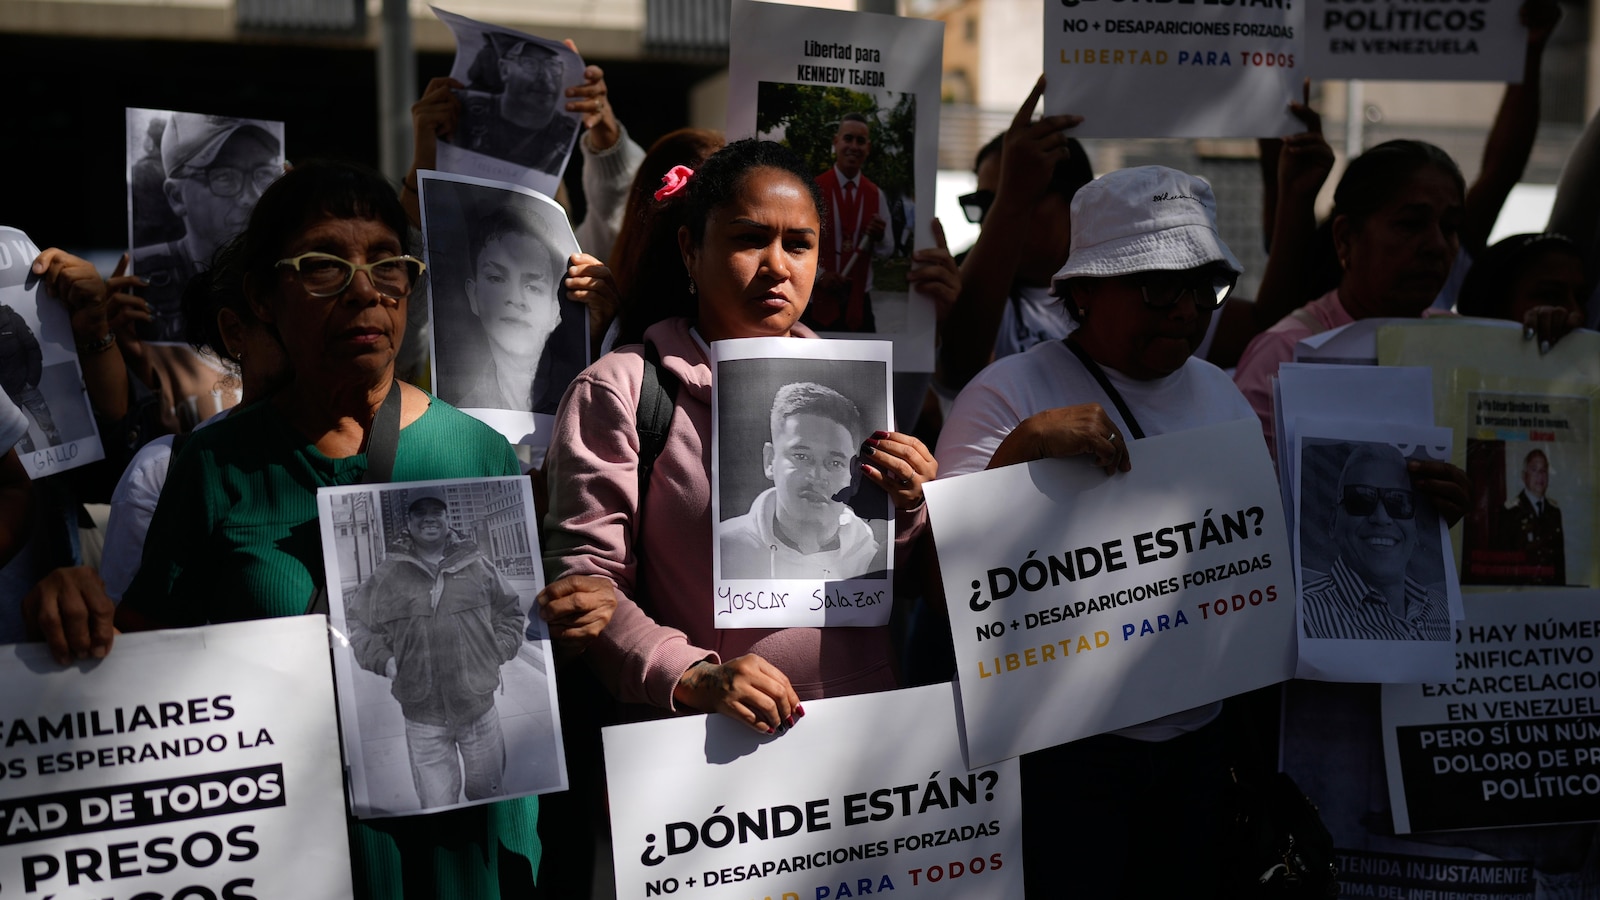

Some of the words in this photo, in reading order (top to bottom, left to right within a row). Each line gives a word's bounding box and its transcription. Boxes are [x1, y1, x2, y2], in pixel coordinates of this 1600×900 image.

[1063, 19, 1088, 33] NO
[1105, 19, 1230, 36] DESAPARICIONES
[1233, 23, 1294, 39] FORZADAS
[1324, 5, 1486, 31] POLÍTICOS
[804, 40, 852, 60] Libertad
[855, 47, 880, 63] para
[1060, 49, 1168, 65] LIBERTAD
[1178, 51, 1231, 66] PARA
[1240, 52, 1295, 69] TODOS
[1329, 39, 1355, 53] EN
[1361, 39, 1479, 54] VENEZUELA
[797, 64, 846, 84] KENNEDY
[848, 68, 885, 87] TEJEDA
[33, 443, 79, 471] GALLO
[969, 539, 1127, 612] ¿DÓNDE
[1133, 506, 1264, 565] ESTÁN?
[809, 589, 885, 611] Salazar
[976, 621, 1005, 641] NO
[1025, 577, 1180, 629] DESAPARICIONES
[1183, 553, 1272, 590] FORZADAS
[977, 629, 1110, 679] LIBERTAD
[1123, 610, 1189, 641] PARA
[1198, 585, 1278, 620] TODOS
[1470, 624, 1517, 644] HAY
[1422, 671, 1600, 697] EXCARCELACIO
[0, 695, 235, 748] AMILIARES
[1447, 703, 1477, 721] EN
[1419, 727, 1485, 750] PERO
[1490, 721, 1511, 746] SÍ
[1516, 724, 1549, 744] UN
[37, 733, 228, 775] ESPERANDO
[238, 727, 275, 749] LA
[1432, 751, 1532, 775] DOLORO
[1537, 749, 1569, 768] DE
[1481, 771, 1600, 802] POLÍTICO
[0, 802, 68, 837] AD
[80, 792, 136, 826] DE
[144, 772, 282, 817] TODOS
[640, 798, 831, 867] ¿DÓNDE
[844, 770, 999, 827] ESTÁN?
[22, 825, 260, 893] PRESOS
[645, 877, 679, 898] NO
[703, 841, 889, 889] DESAPARICIONES
[895, 820, 1001, 854] FORZADAS
[816, 874, 895, 900] PARA
[908, 853, 1004, 886] TODOS
[1406, 861, 1529, 885] INJUSTAMENTE
[1378, 884, 1405, 900] DEL
